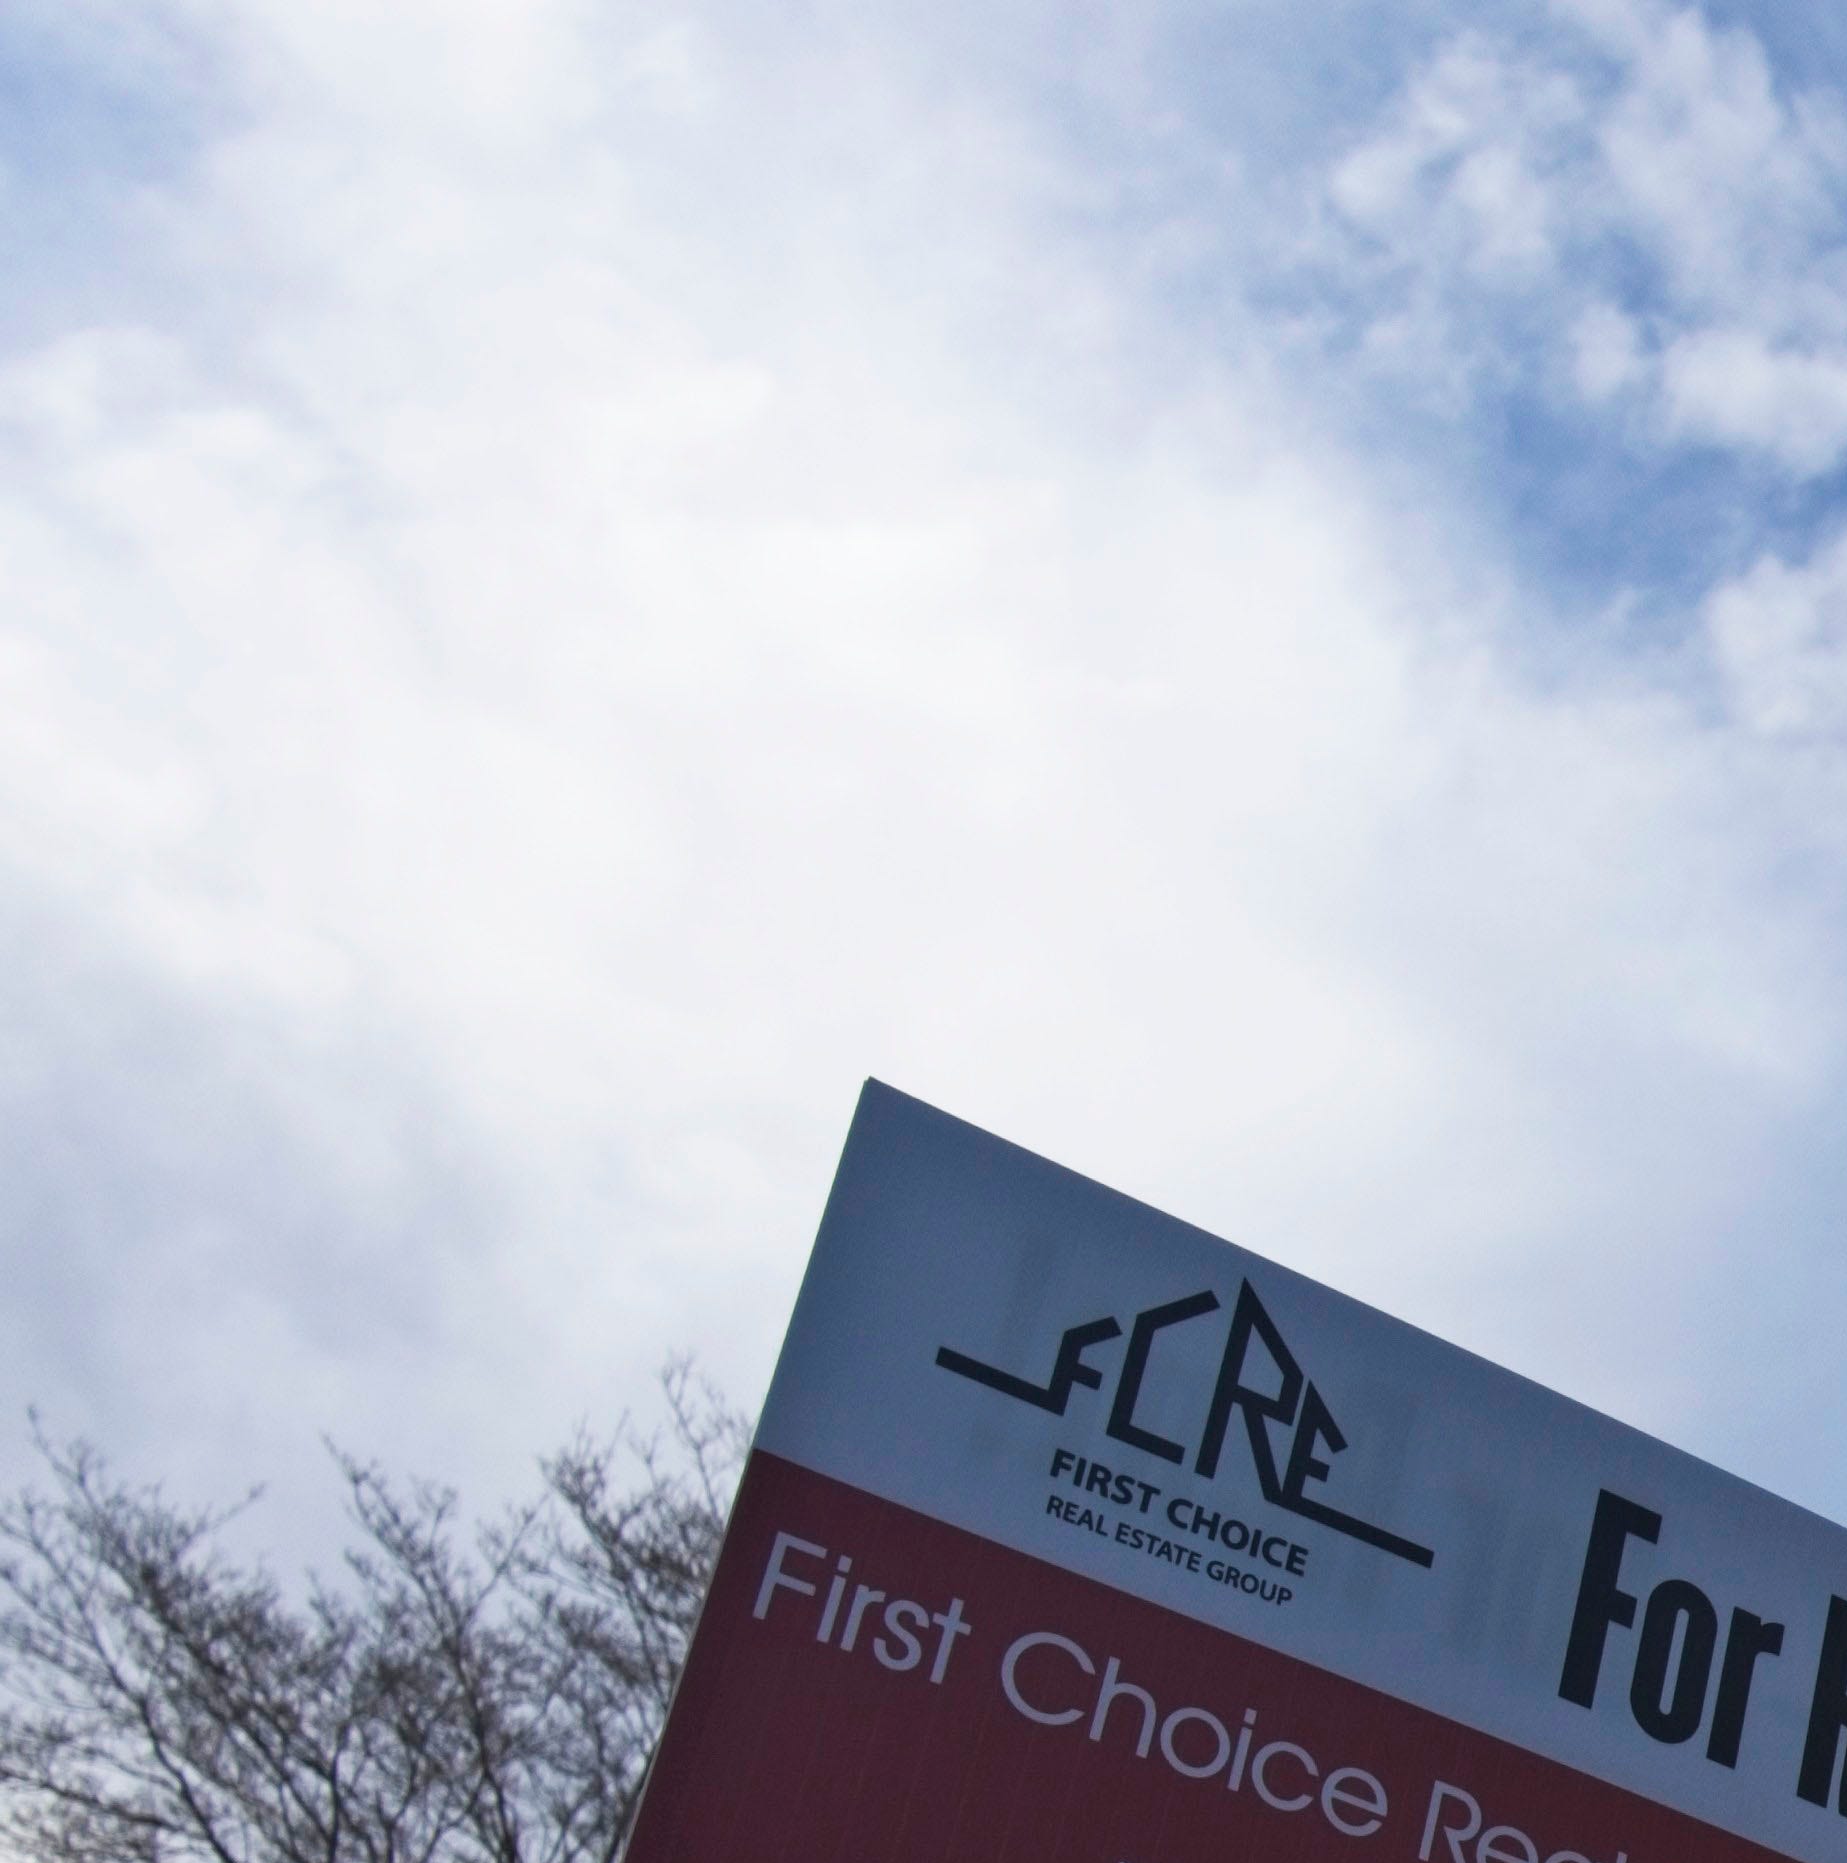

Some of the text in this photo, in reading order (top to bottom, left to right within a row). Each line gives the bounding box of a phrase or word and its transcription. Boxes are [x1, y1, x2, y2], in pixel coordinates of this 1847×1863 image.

[1045, 1495, 1293, 1607] REAL ESTATE GROUP
[1048, 1448, 1310, 1578] FIRST CHOICE
[751, 1530, 972, 1685] First
[1001, 1631, 1389, 1837] Choice
[1557, 1487, 1785, 1771] For
